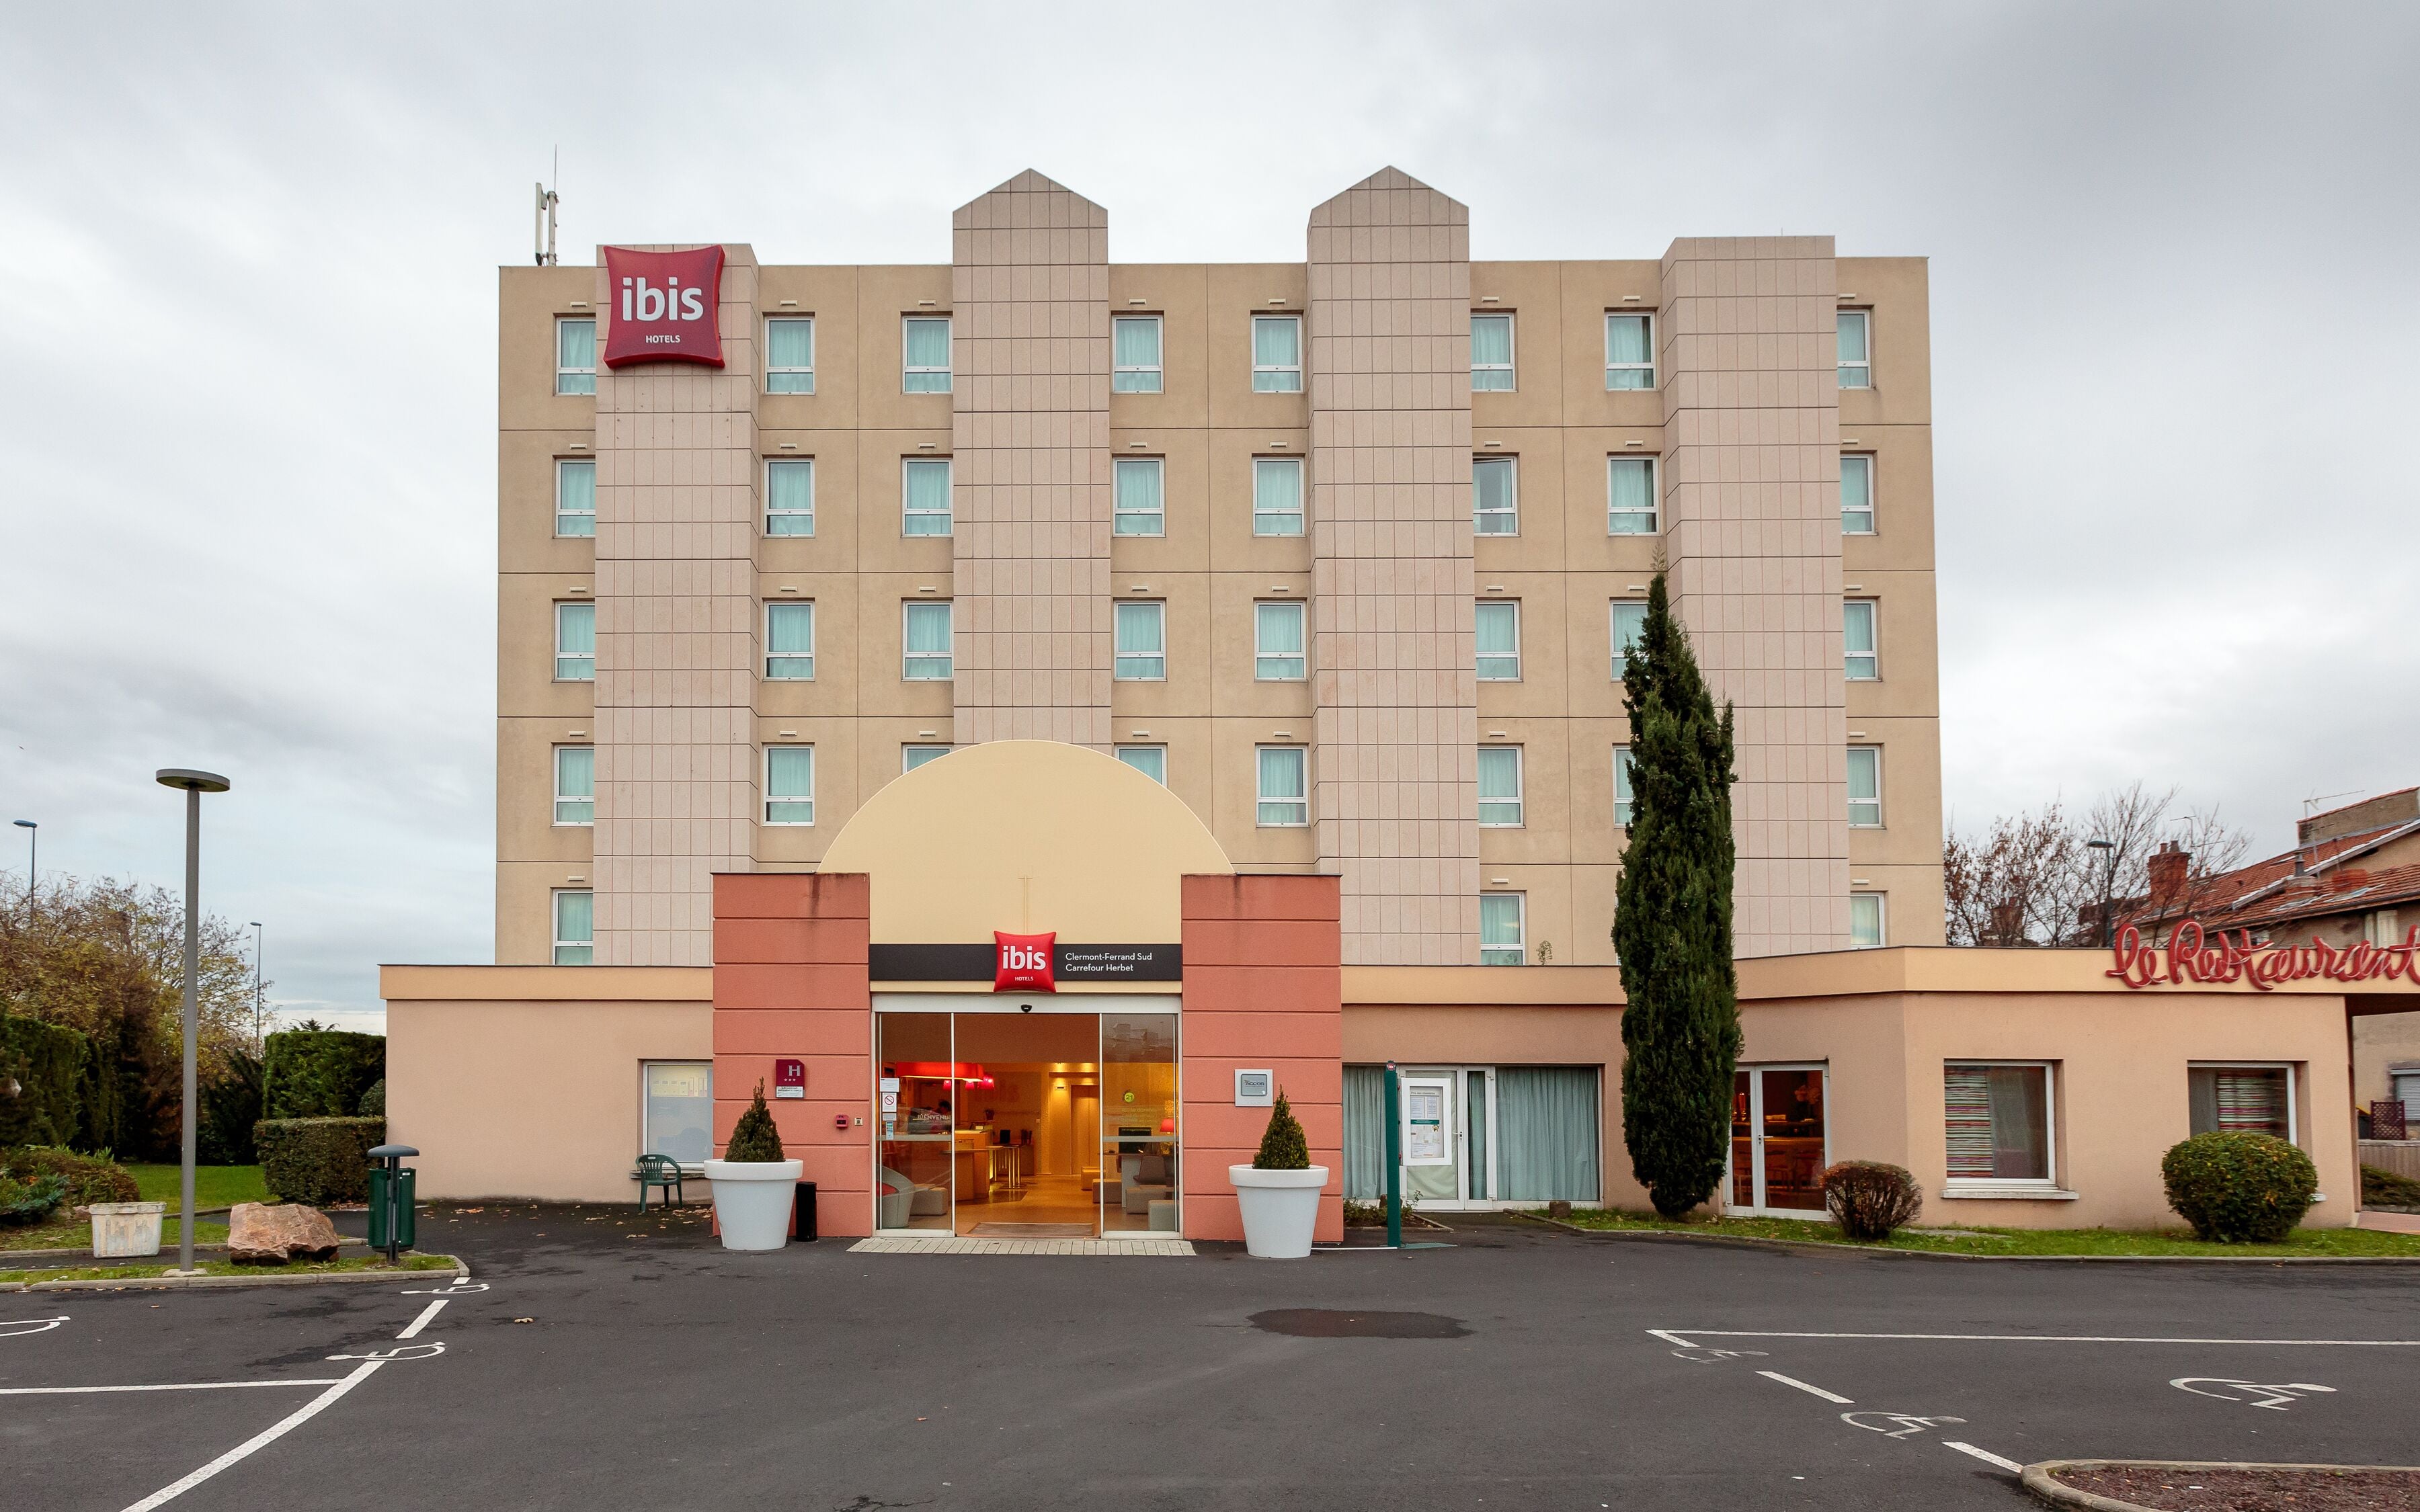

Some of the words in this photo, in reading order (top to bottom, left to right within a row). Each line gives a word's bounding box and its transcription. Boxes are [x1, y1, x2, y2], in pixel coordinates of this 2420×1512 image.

[622, 276, 704, 322] ibis
[645, 335, 681, 343] HOTELS
[1003, 946, 1046, 970] ibis
[1065, 952, 1135, 960] Clermont-Ferrand
[1137, 952, 1152, 960] Sud
[1065, 963, 1104, 971] Carrefour
[788, 1065, 801, 1076] H
